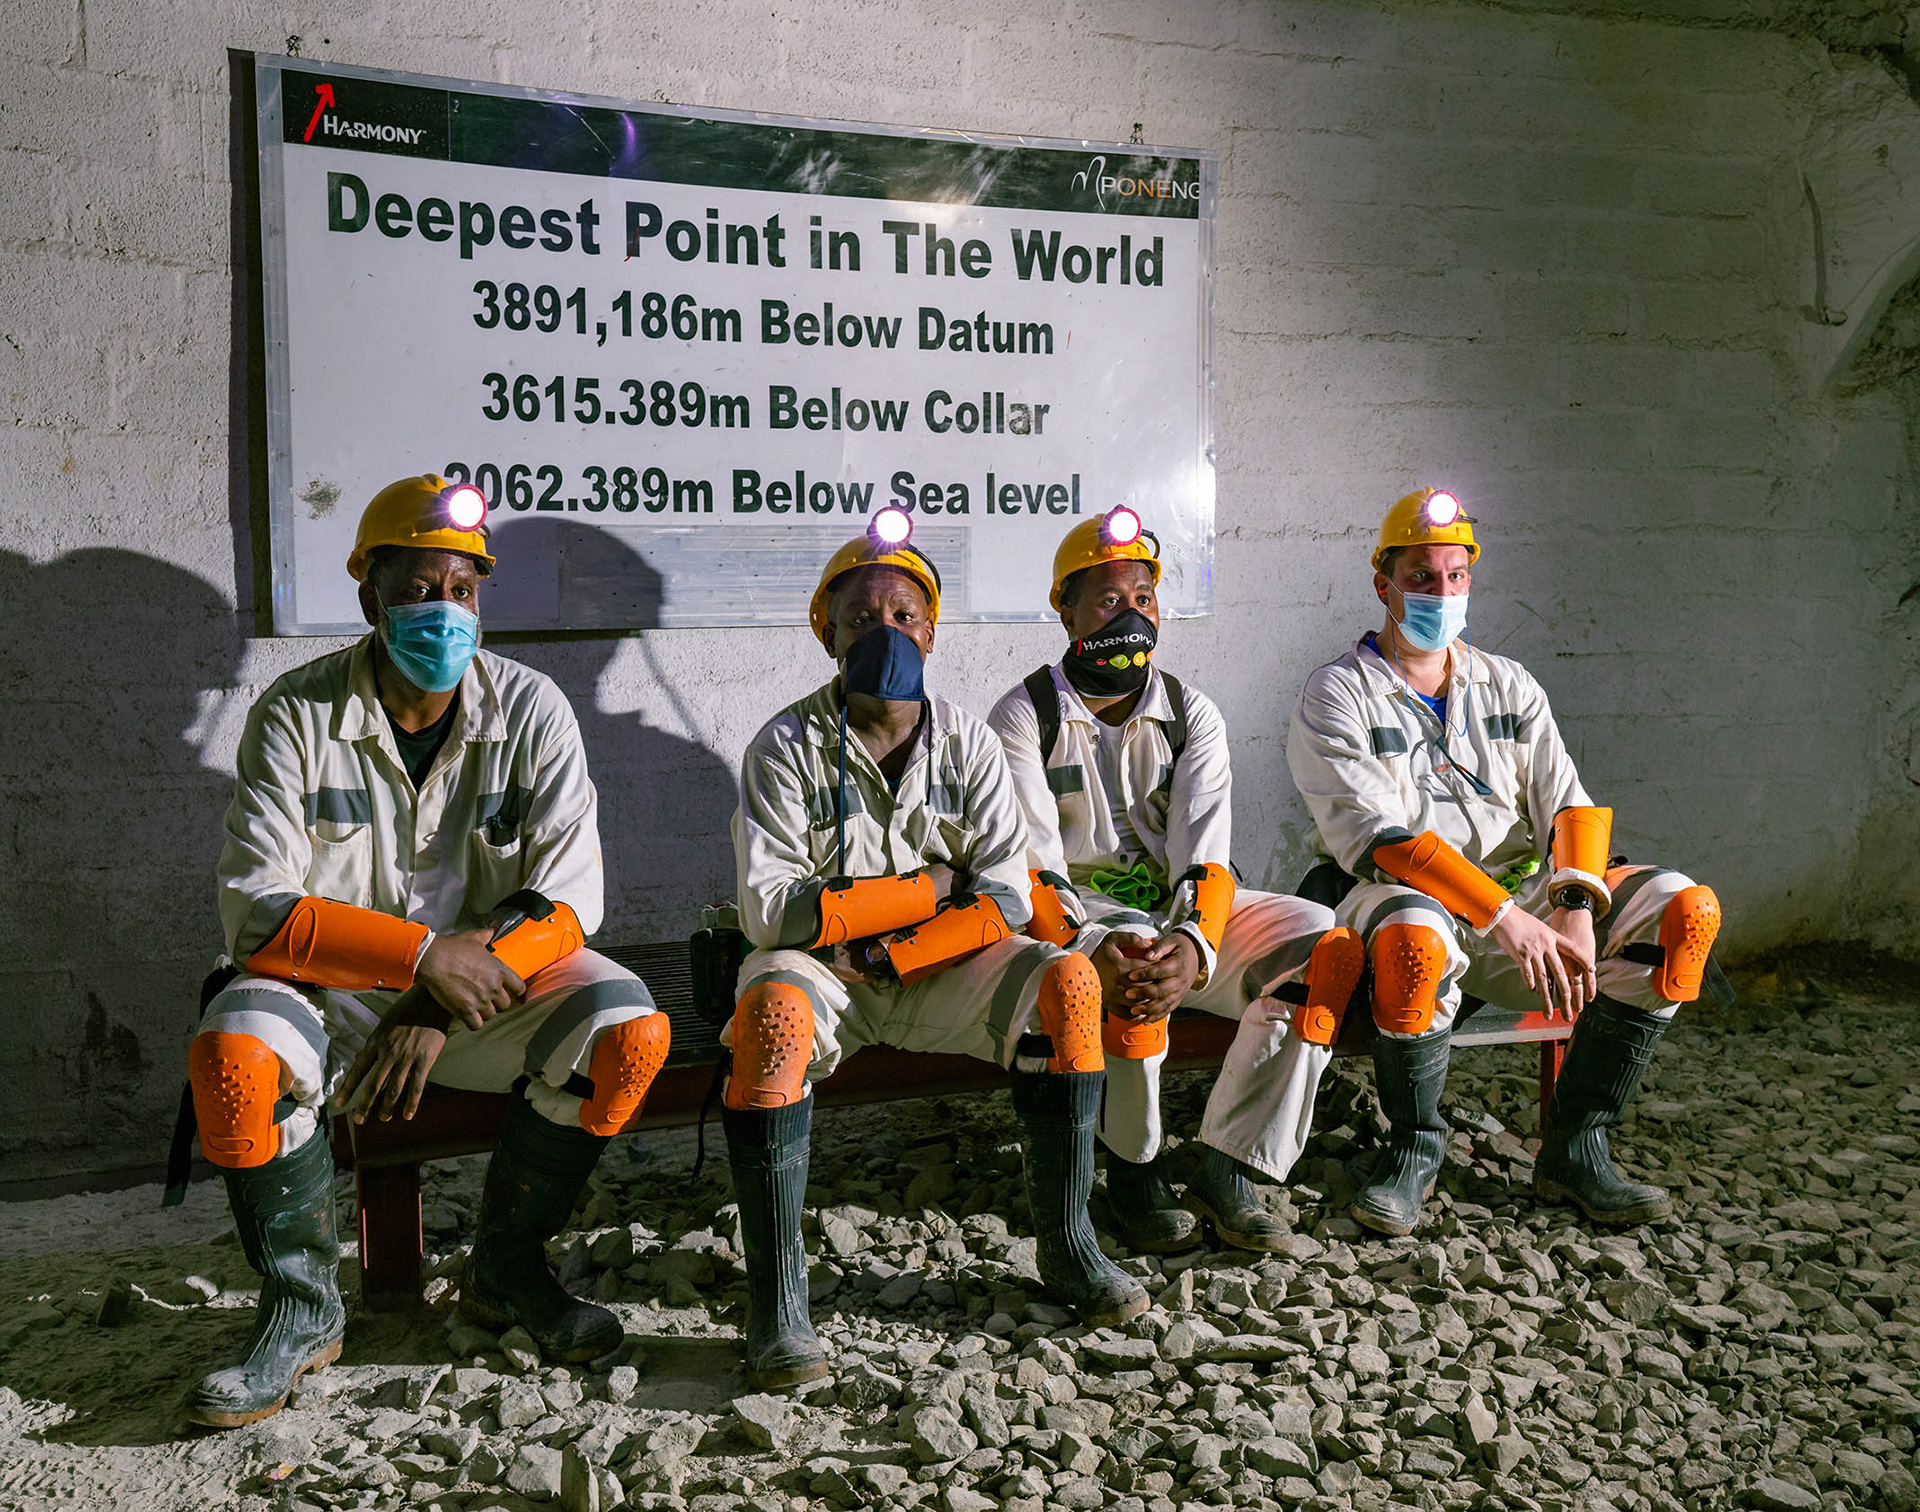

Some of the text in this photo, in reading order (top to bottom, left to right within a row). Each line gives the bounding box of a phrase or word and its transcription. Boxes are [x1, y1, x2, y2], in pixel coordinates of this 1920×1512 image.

[323, 114, 422, 144] HARMONY
[327, 171, 1163, 286] Deepest Point in The World
[473, 280, 1053, 354] 3891,186m Below Datum
[482, 373, 1050, 435] 3615.389m Below Collar
[733, 470, 874, 513] Below
[890, 471, 969, 514] Sea
[987, 473, 1079, 514] level
